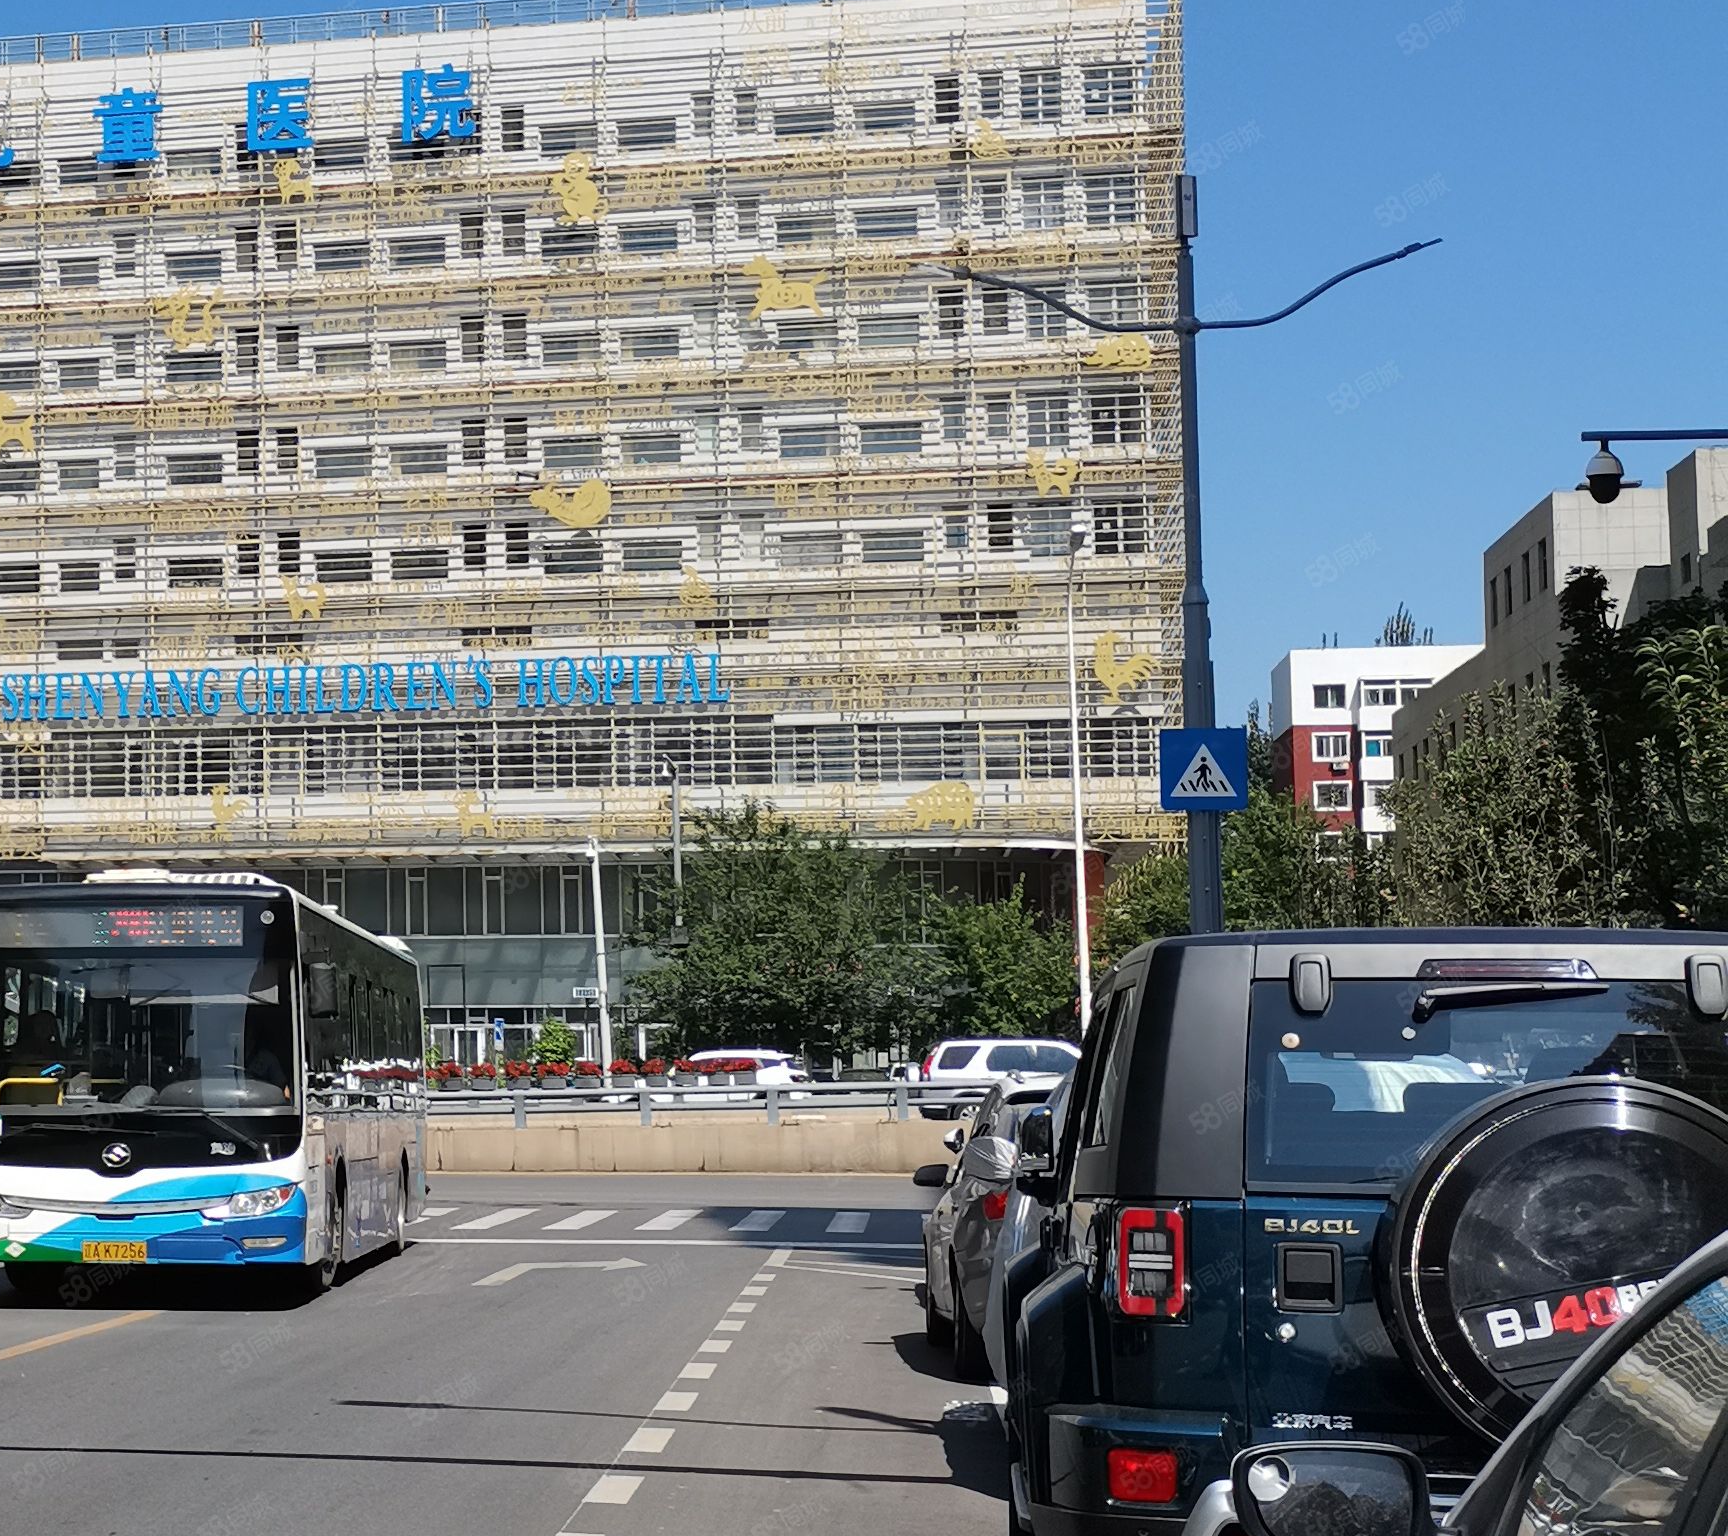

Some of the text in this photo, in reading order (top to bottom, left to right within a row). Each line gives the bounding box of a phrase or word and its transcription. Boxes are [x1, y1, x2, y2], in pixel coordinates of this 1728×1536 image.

[2, 651, 730, 721] SHENYANG CHILDREN'S HOSPITAL
[1264, 1217, 1360, 1235] BJ40L
